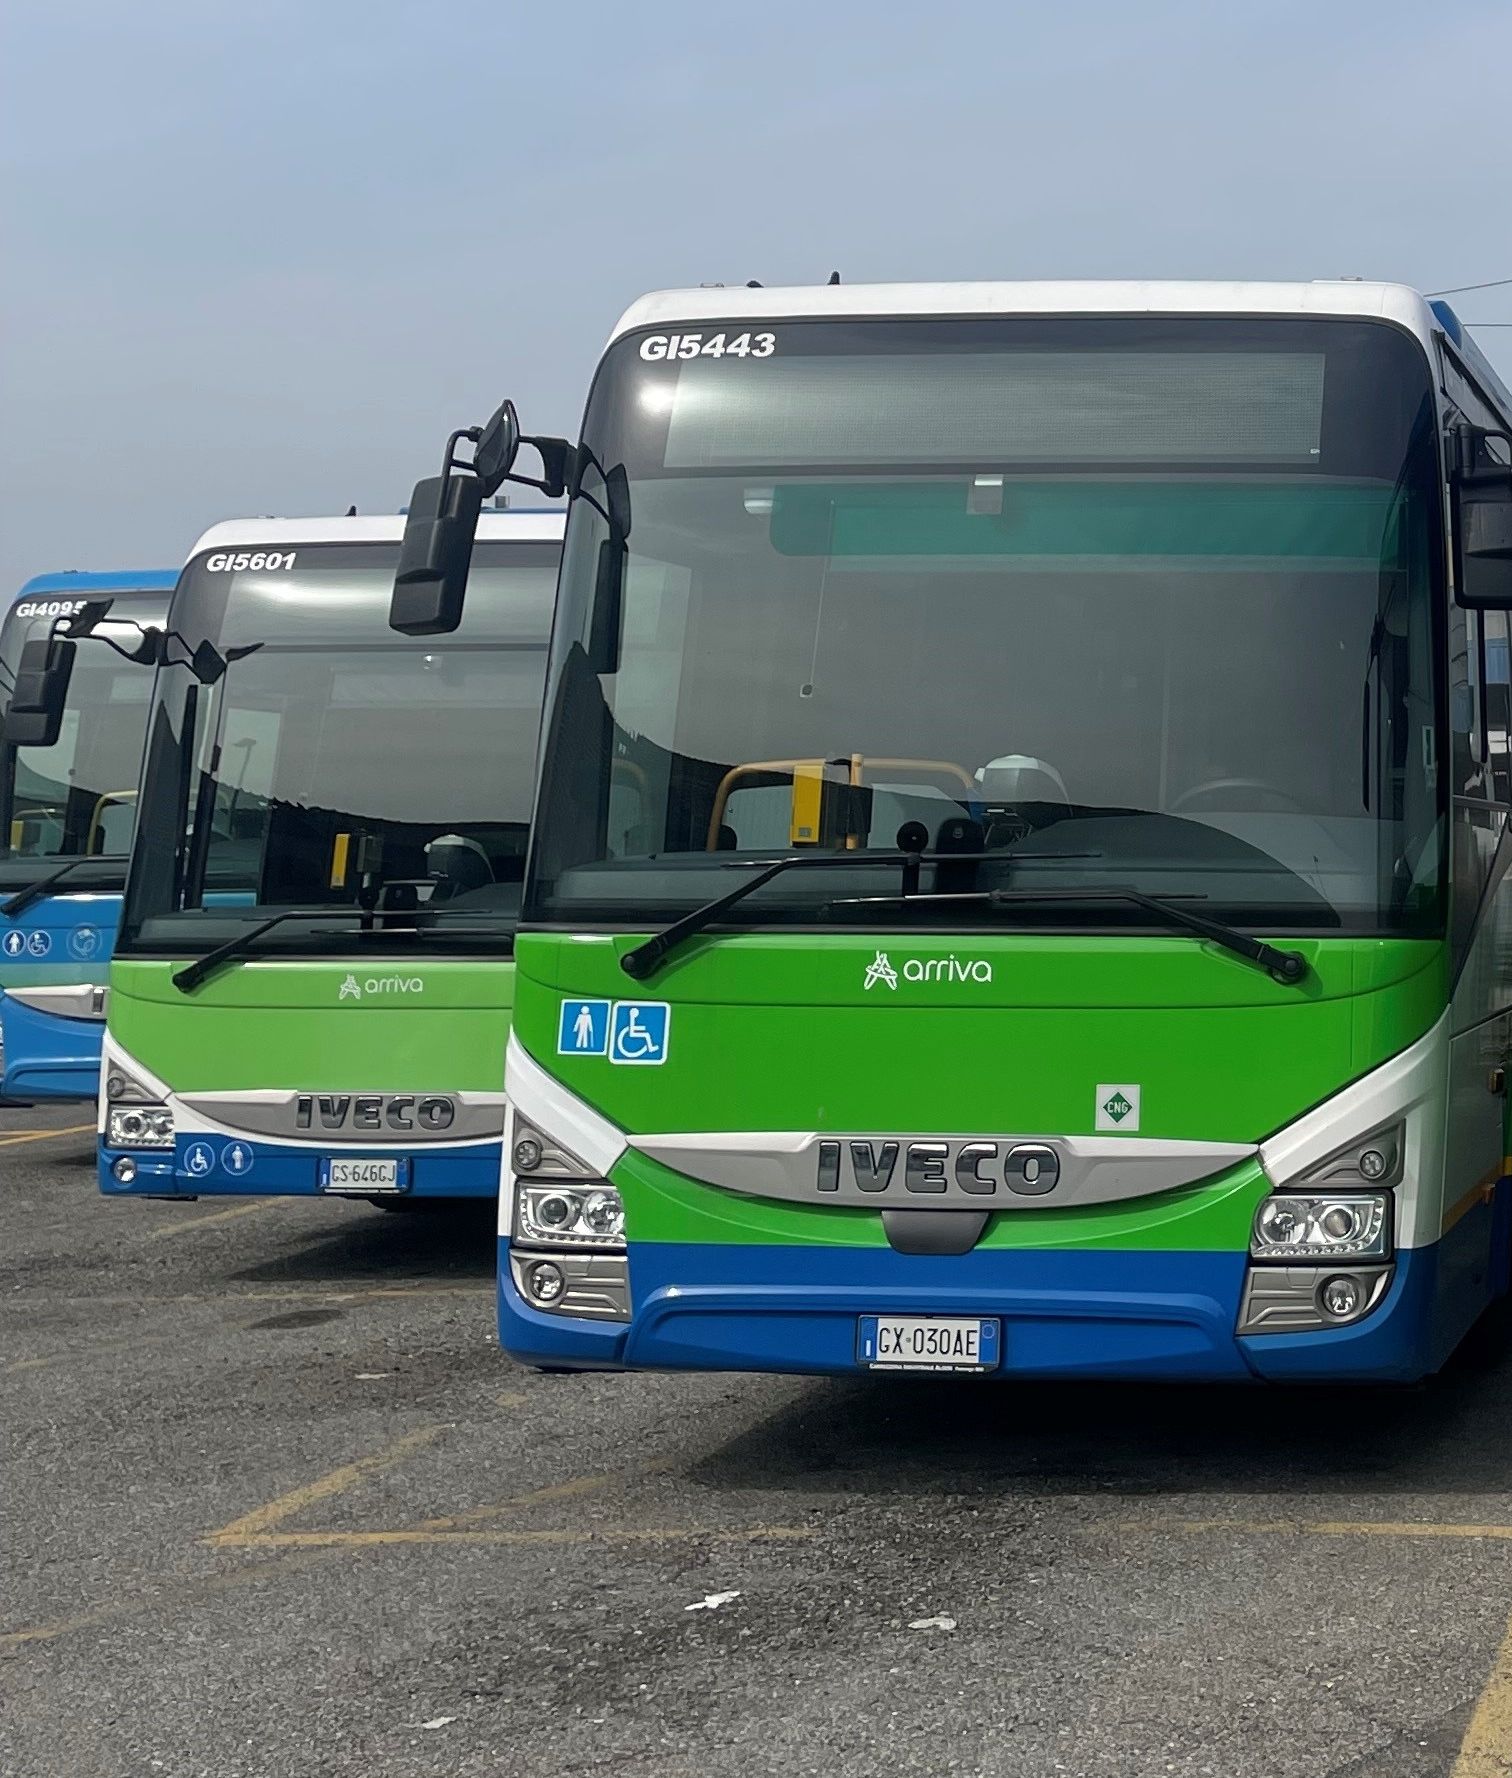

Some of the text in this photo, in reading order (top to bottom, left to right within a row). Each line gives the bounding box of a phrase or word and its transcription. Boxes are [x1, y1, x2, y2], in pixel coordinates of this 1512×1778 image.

[639, 332, 776, 361] GI5443
[206, 552, 296, 572] GI5601
[903, 953, 992, 983] arriva
[364, 973, 424, 994] arriva
[296, 1095, 454, 1130] IVECO
[1107, 1101, 1129, 1114] CNG
[817, 1140, 1060, 1196] IVECO
